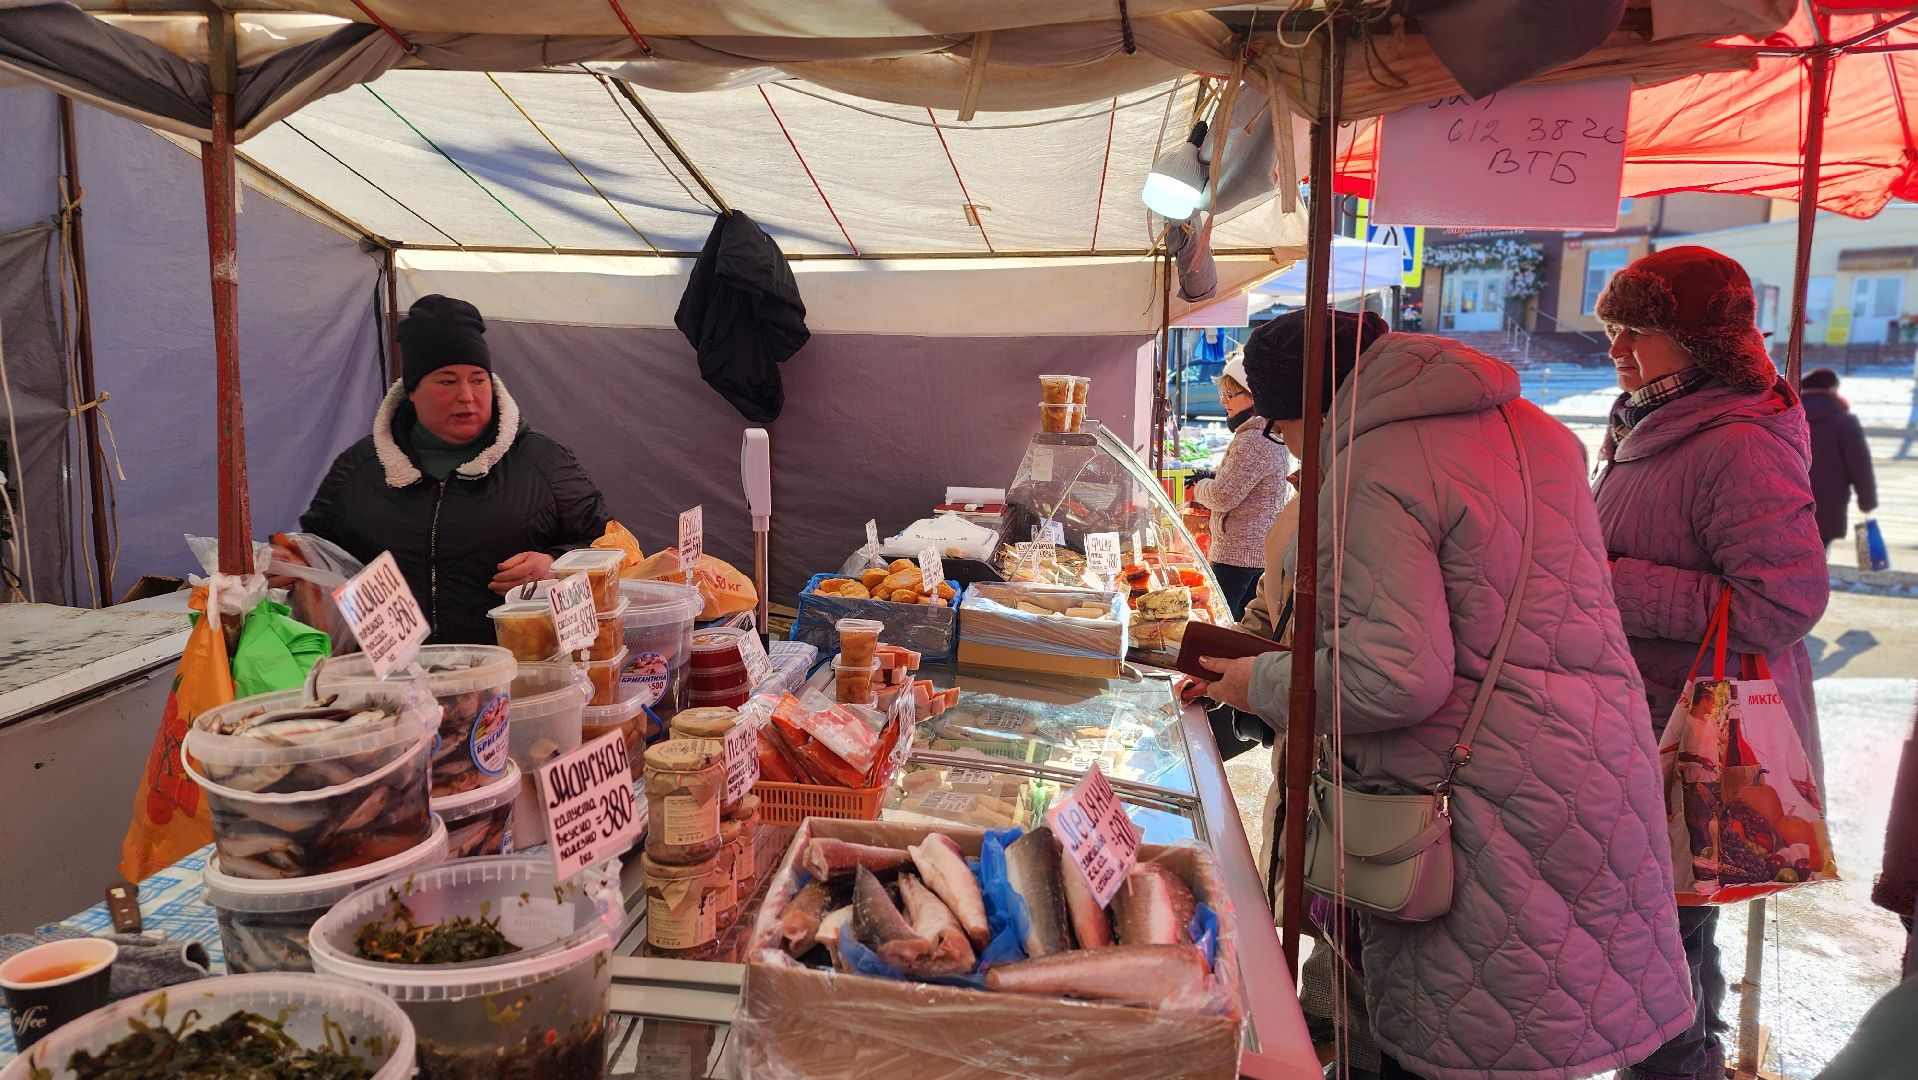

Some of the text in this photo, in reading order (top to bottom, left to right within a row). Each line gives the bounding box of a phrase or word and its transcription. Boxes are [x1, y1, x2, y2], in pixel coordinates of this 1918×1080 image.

[1488, 148, 1587, 185] ВТБ
[621, 674, 667, 683] БРИГАНТИНА
[553, 798, 597, 830] капуста
